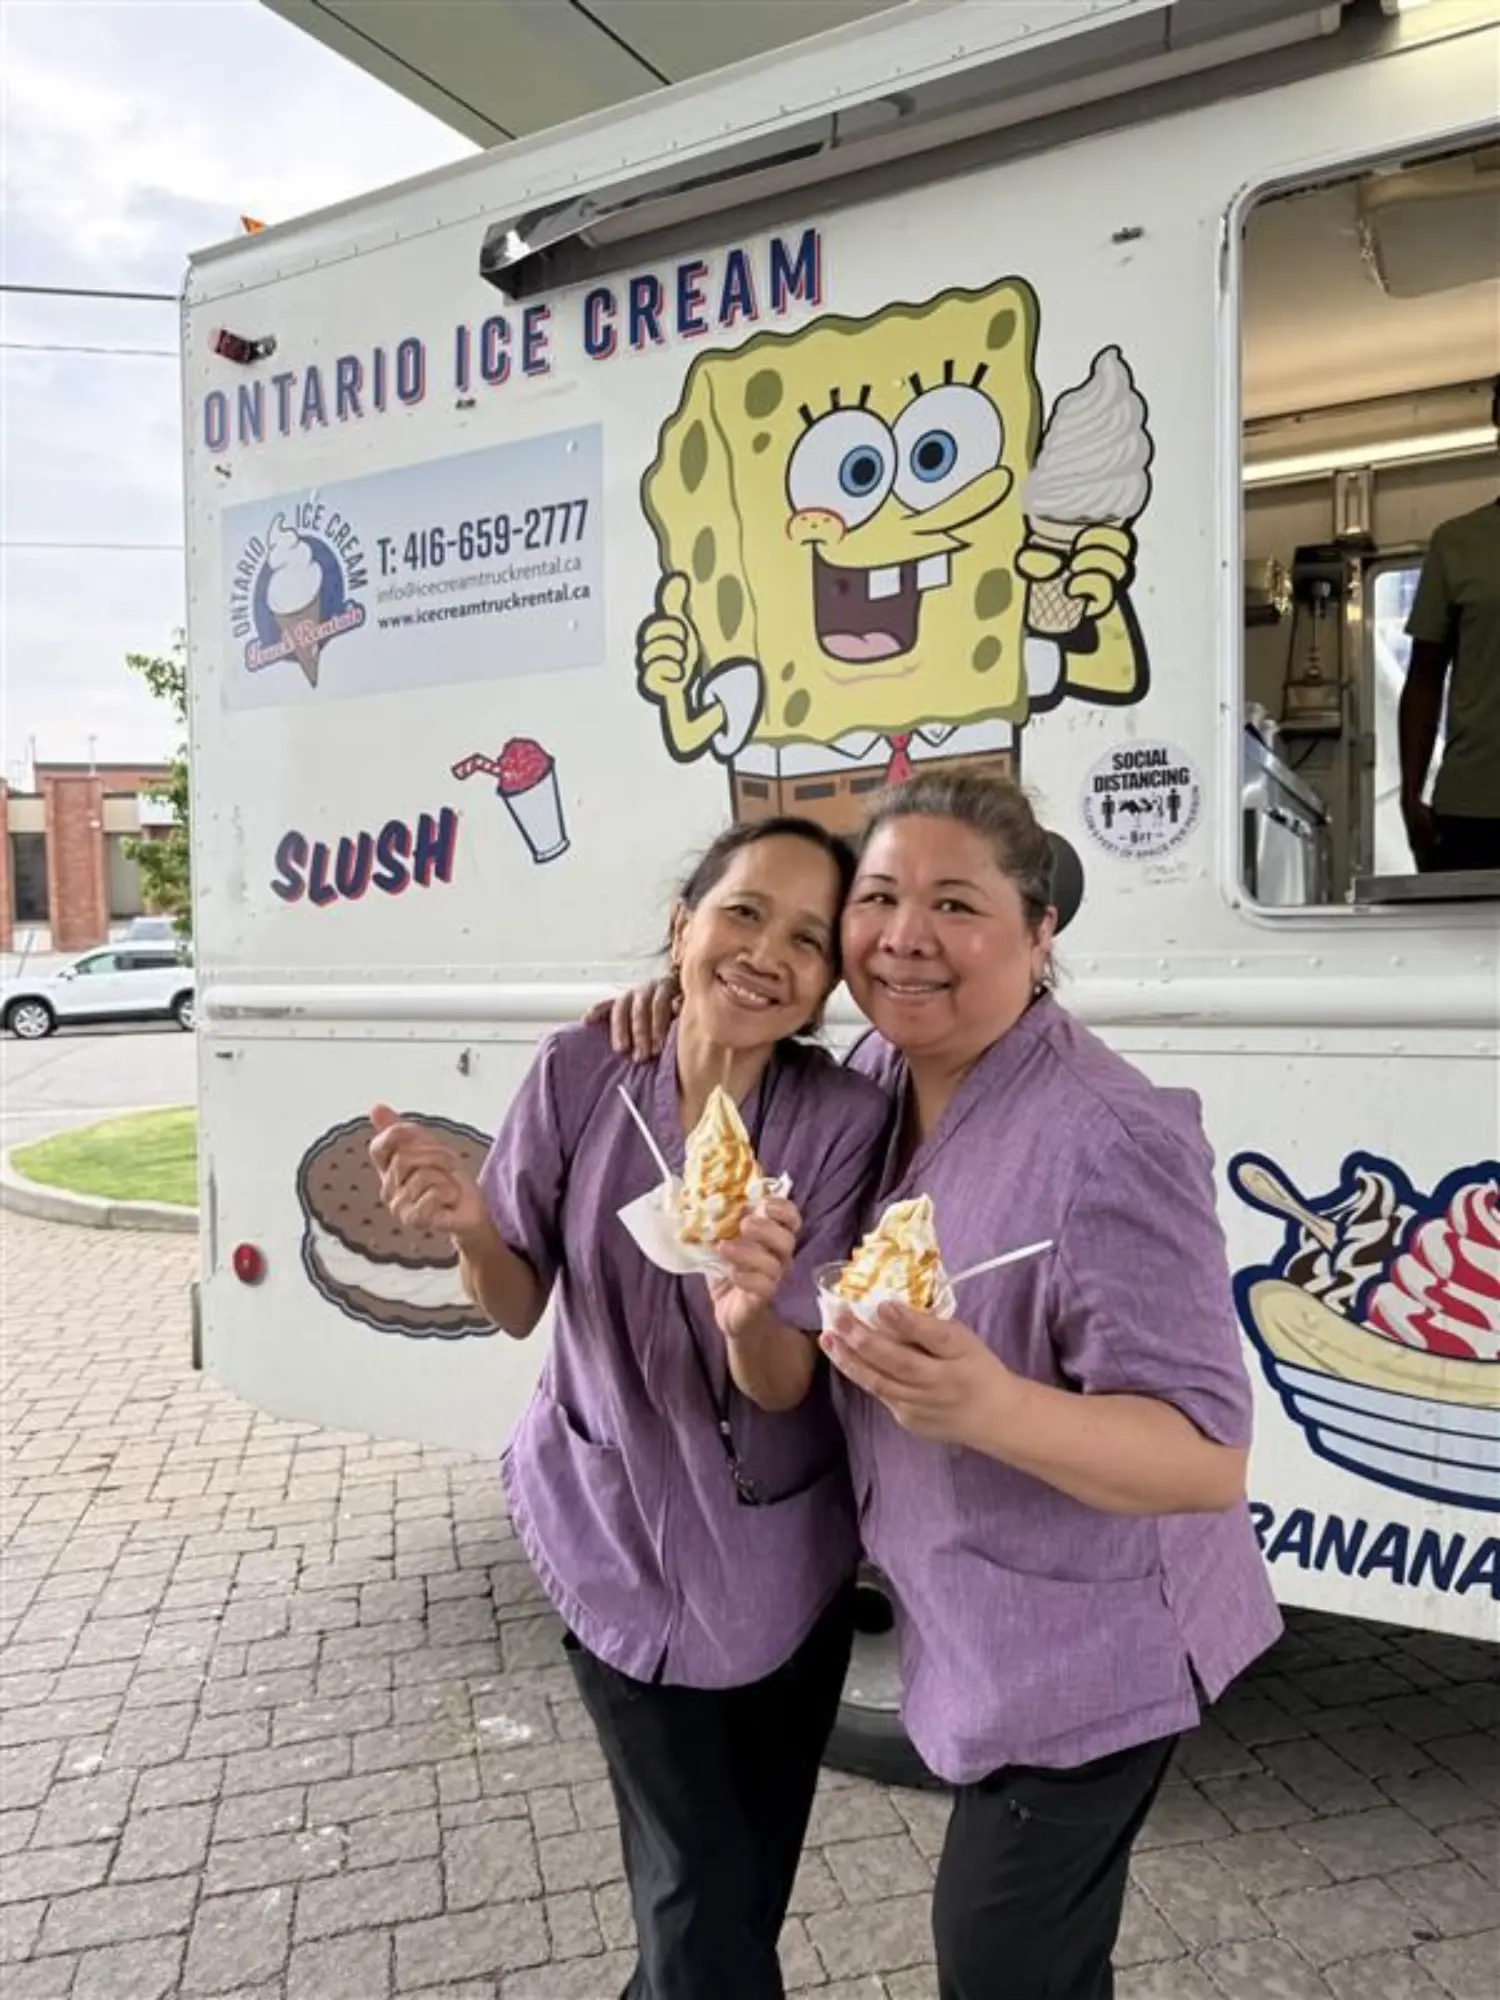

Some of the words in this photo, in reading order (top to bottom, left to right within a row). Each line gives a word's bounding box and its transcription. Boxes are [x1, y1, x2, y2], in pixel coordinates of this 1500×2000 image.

[203, 336, 427, 453] ONTARIO
[456, 304, 551, 392] ICE
[583, 228, 824, 360] CREAM
[377, 537, 397, 576] T:
[403, 498, 589, 571] 416-659-2777
[231, 535, 267, 639] ONTARIO
[296, 502, 326, 530] ICE
[325, 512, 369, 591] CREAM
[377, 556, 582, 602] info@icecreamtruckrental.ca
[378, 583, 591, 629] www.icecreamtruckrental.ca
[1093, 767, 1191, 793] DISTANCING
[1112, 748, 1169, 771] SOCIAL
[270, 807, 458, 907] SLUSH
